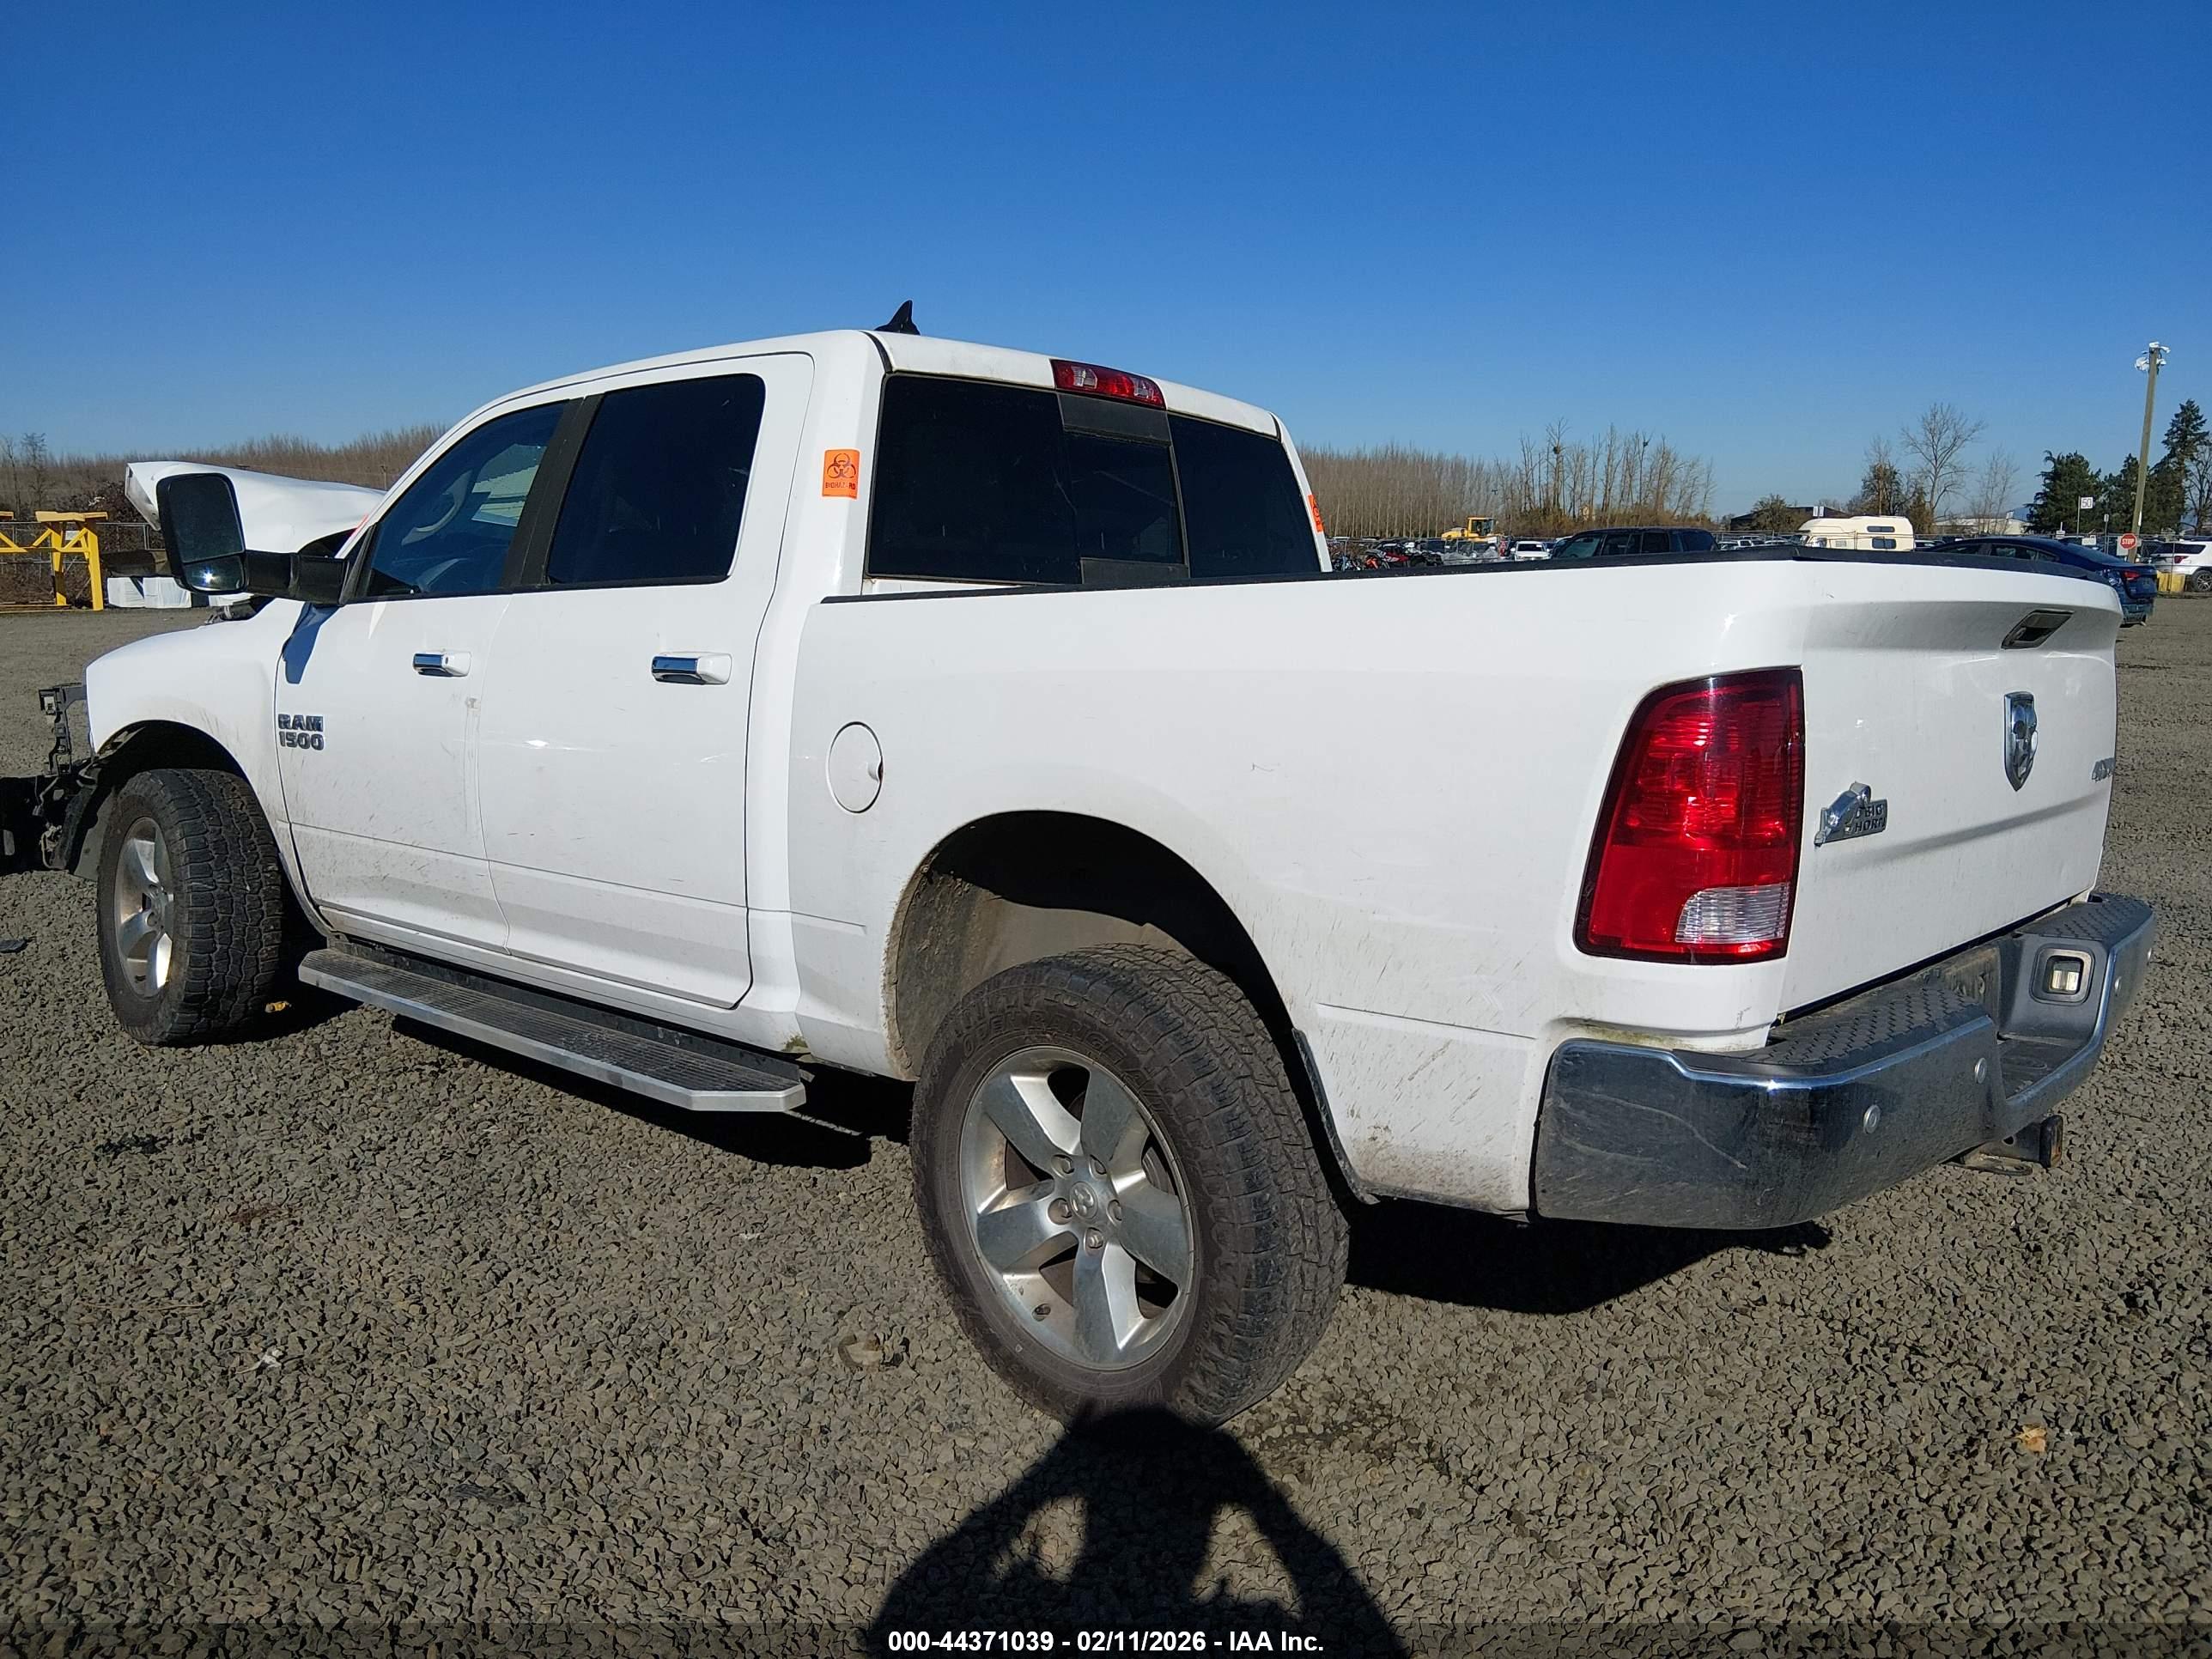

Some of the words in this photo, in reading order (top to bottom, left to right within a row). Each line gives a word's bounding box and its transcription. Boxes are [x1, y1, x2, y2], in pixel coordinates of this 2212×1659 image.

[278, 714, 323, 732] RAM
[279, 732, 324, 750] 1500
[1865, 804, 1883, 817] BIG
[1855, 817, 1886, 832] HORN
